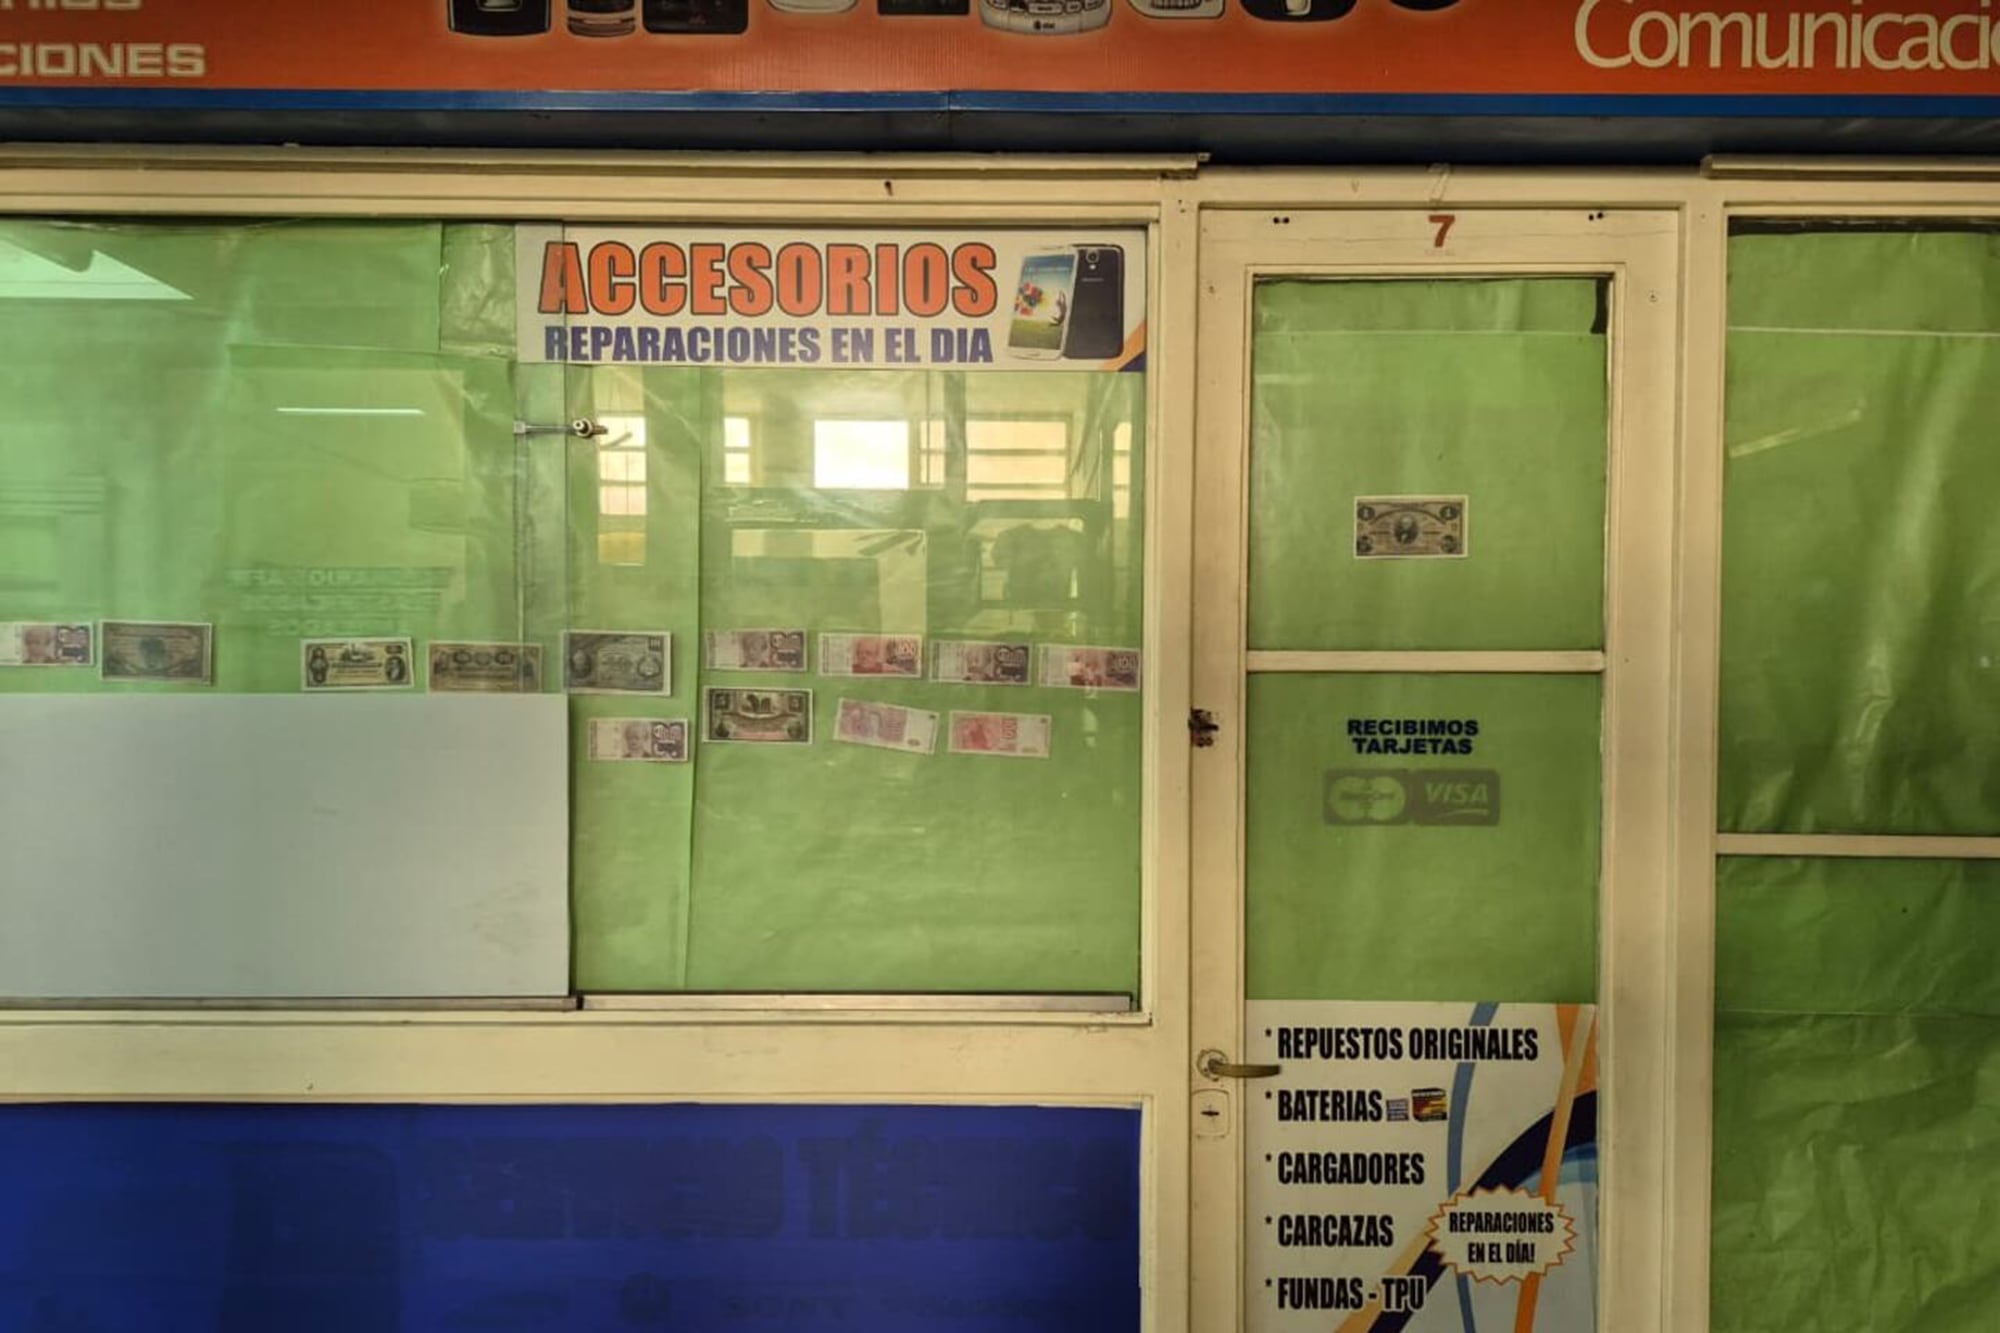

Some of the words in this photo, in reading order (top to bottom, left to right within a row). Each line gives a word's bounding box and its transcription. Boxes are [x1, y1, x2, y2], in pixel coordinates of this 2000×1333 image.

[1574, 0, 2000, 70] Comunicaci
[1428, 214, 1456, 248] 7
[537, 241, 998, 317] ACCESORIOS
[544, 326, 821, 363] REPARACIONES
[831, 328, 874, 363] EN
[885, 328, 921, 363] EL
[930, 328, 994, 364] DIA
[1347, 719, 1478, 736] RECIBIMOS
[1352, 738, 1473, 755] TARJETAS
[1424, 782, 1489, 805] VISA
[1277, 1027, 1403, 1061] REPUESTOS
[1409, 1027, 1539, 1061] ORIGINALES
[1277, 1089, 1383, 1122] BATERIAS
[1277, 1151, 1425, 1185] CARGADORES
[1277, 1214, 1394, 1247] CARCAZAS
[1448, 1211, 1554, 1234] REPARACIONES
[1467, 1243, 1486, 1263] EN
[1488, 1243, 1502, 1263] EL
[1505, 1238, 1536, 1263] DÍA!
[1277, 1277, 1363, 1310] FUNDAS
[1382, 1277, 1426, 1310] TPU
